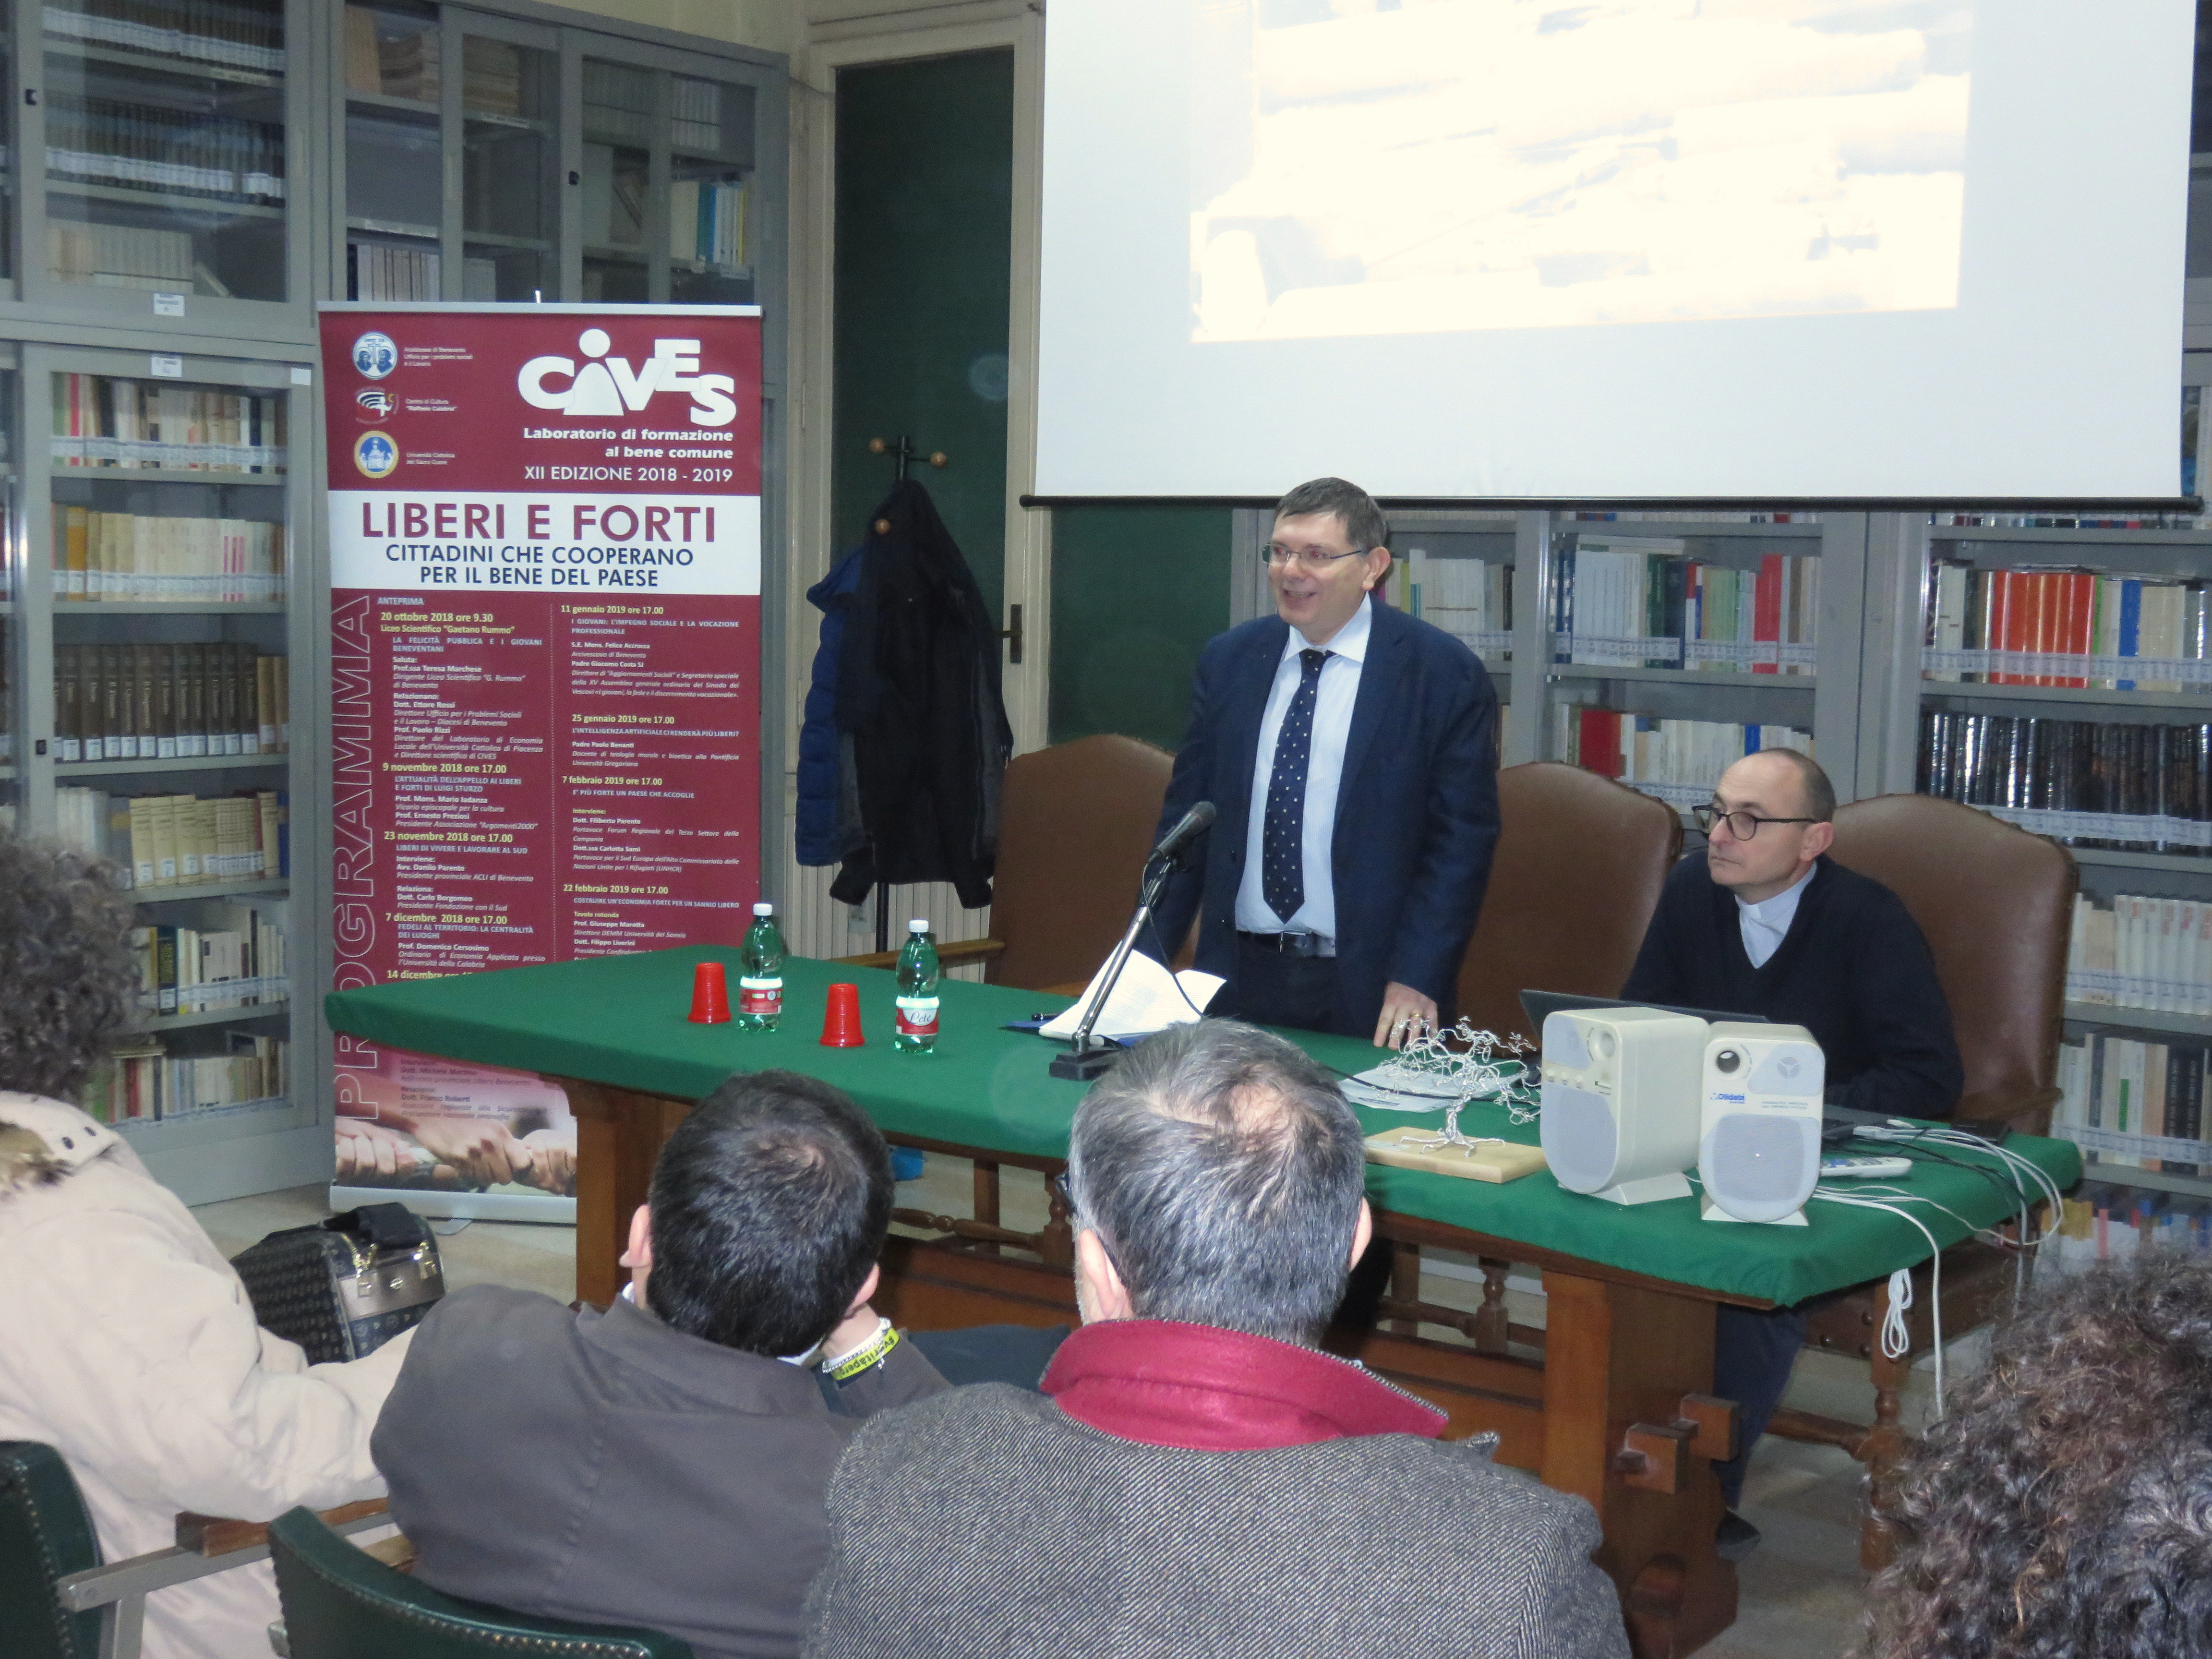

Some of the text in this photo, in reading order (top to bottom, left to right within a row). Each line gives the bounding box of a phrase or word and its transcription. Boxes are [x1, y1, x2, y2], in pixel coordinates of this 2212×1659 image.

[524, 428, 733, 441] Laboratorio di formazione
[605, 446, 733, 459] al bene comune
[525, 466, 544, 480] XII
[551, 466, 632, 481] EDIZIONE
[638, 467, 677, 481] 2018
[693, 468, 733, 482] 2019
[362, 502, 715, 542] LIBERI E FORTI
[386, 544, 693, 566] CITTADINI CHE COOPERANO
[421, 566, 658, 587] PER IL BENE DEL PAESE
[561, 605, 570, 613] 11
[572, 606, 605, 615] gennaio
[607, 605, 626, 613] 2019
[643, 606, 664, 614] 17.00
[381, 612, 392, 621] 20
[394, 612, 428, 622] ottobre
[431, 613, 454, 622] 2018
[473, 613, 493, 623] 9.30
[381, 624, 400, 632] Liceo
[402, 624, 442, 633] Scientifico
[409, 636, 440, 644] FELICITÀ
[572, 714, 582, 722] 25
[583, 714, 616, 724] gennaio
[617, 714, 637, 723] 2019
[654, 716, 674, 724] 17.00
[383, 762, 389, 771] 9
[391, 762, 438, 772] novembre
[440, 763, 462, 773] 2018
[482, 764, 507, 774] 17.00
[395, 775, 438, 783] L'ATTUALITÀ
[569, 776, 602, 784] febbraio
[641, 777, 662, 785] 17.00
[384, 830, 396, 840] 23
[397, 831, 445, 841] novembre
[446, 832, 469, 842] 2018
[488, 833, 513, 843] 17.00
[575, 884, 608, 892] febbraio
[610, 885, 629, 893] 2019
[647, 886, 668, 894] 17.00
[386, 913, 391, 922] 7
[393, 913, 436, 923] dicembre
[441, 914, 463, 923] 2018
[483, 915, 507, 925] 17.00
[387, 970, 443, 979] 14 dicembre
[909, 1011, 931, 1024] Lete
